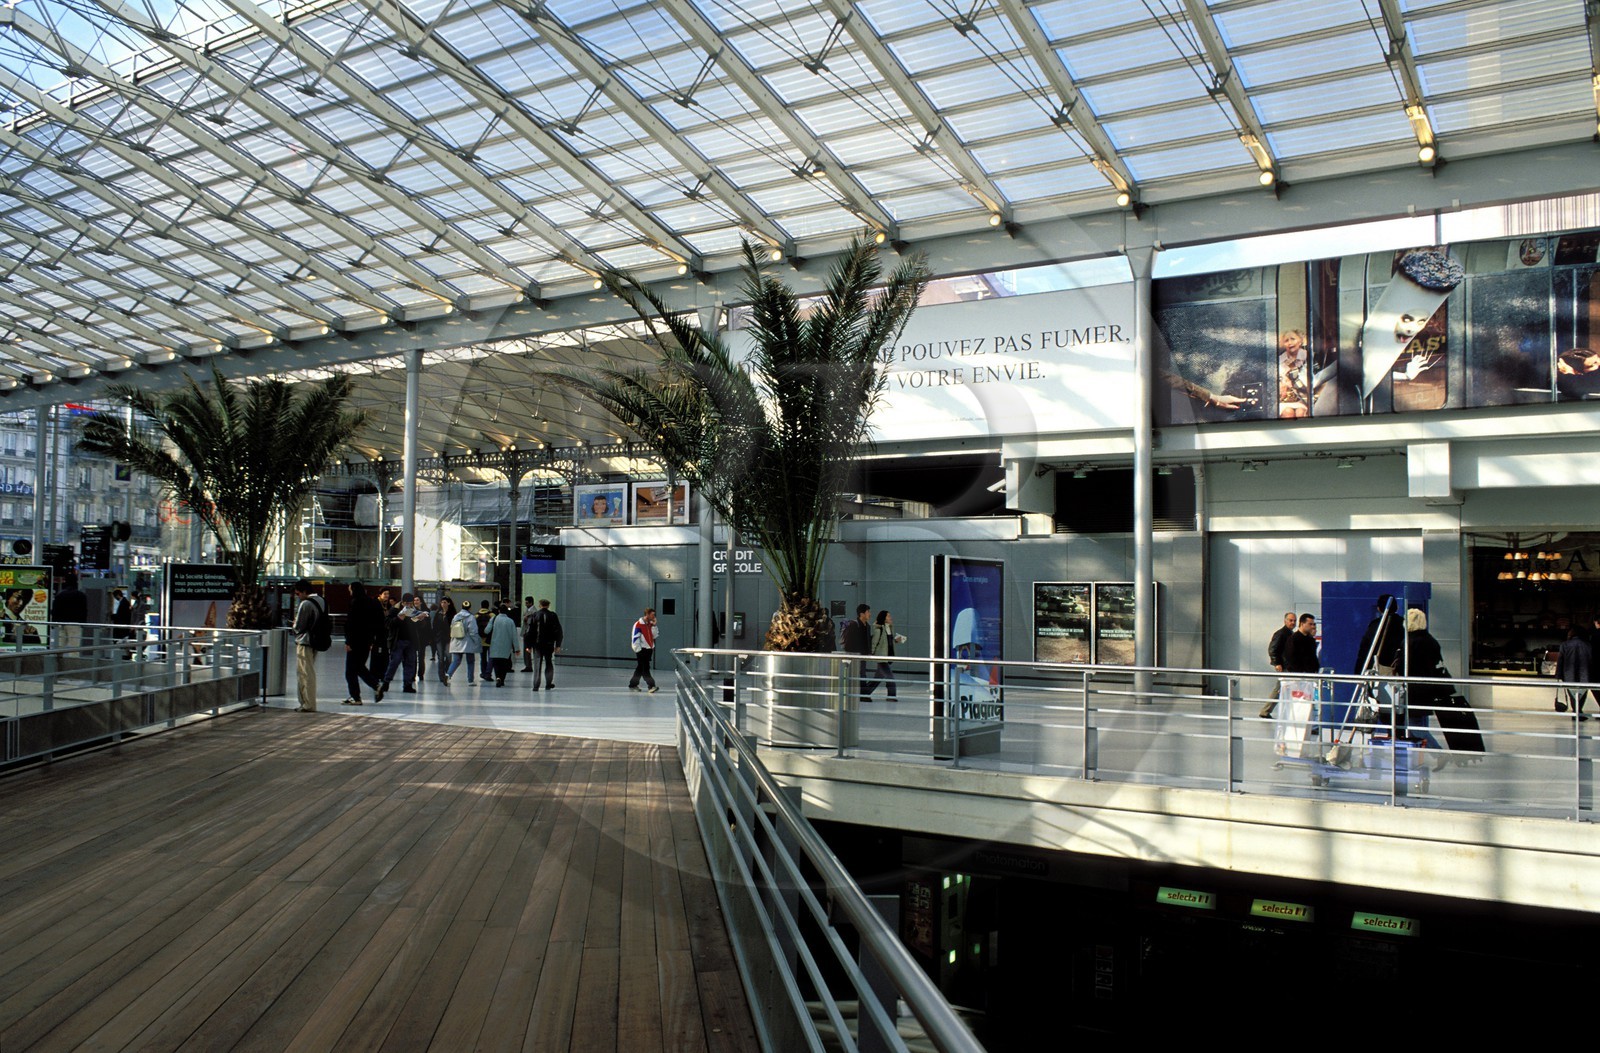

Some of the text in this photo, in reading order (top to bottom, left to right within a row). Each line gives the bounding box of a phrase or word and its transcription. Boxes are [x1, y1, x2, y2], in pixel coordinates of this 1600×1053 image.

[902, 338, 986, 362] POUVEZ
[993, 333, 1032, 354] PAS
[1041, 324, 1131, 350] FUMER,
[897, 366, 965, 389] VOTRE
[972, 361, 1047, 384] ENVIE.
[712, 550, 754, 561] CRDIT
[976, 852, 1046, 872] Photomaton
[1167, 890, 1196, 902] selecta
[1262, 903, 1293, 915] selecta
[1363, 917, 1398, 929] selecta
